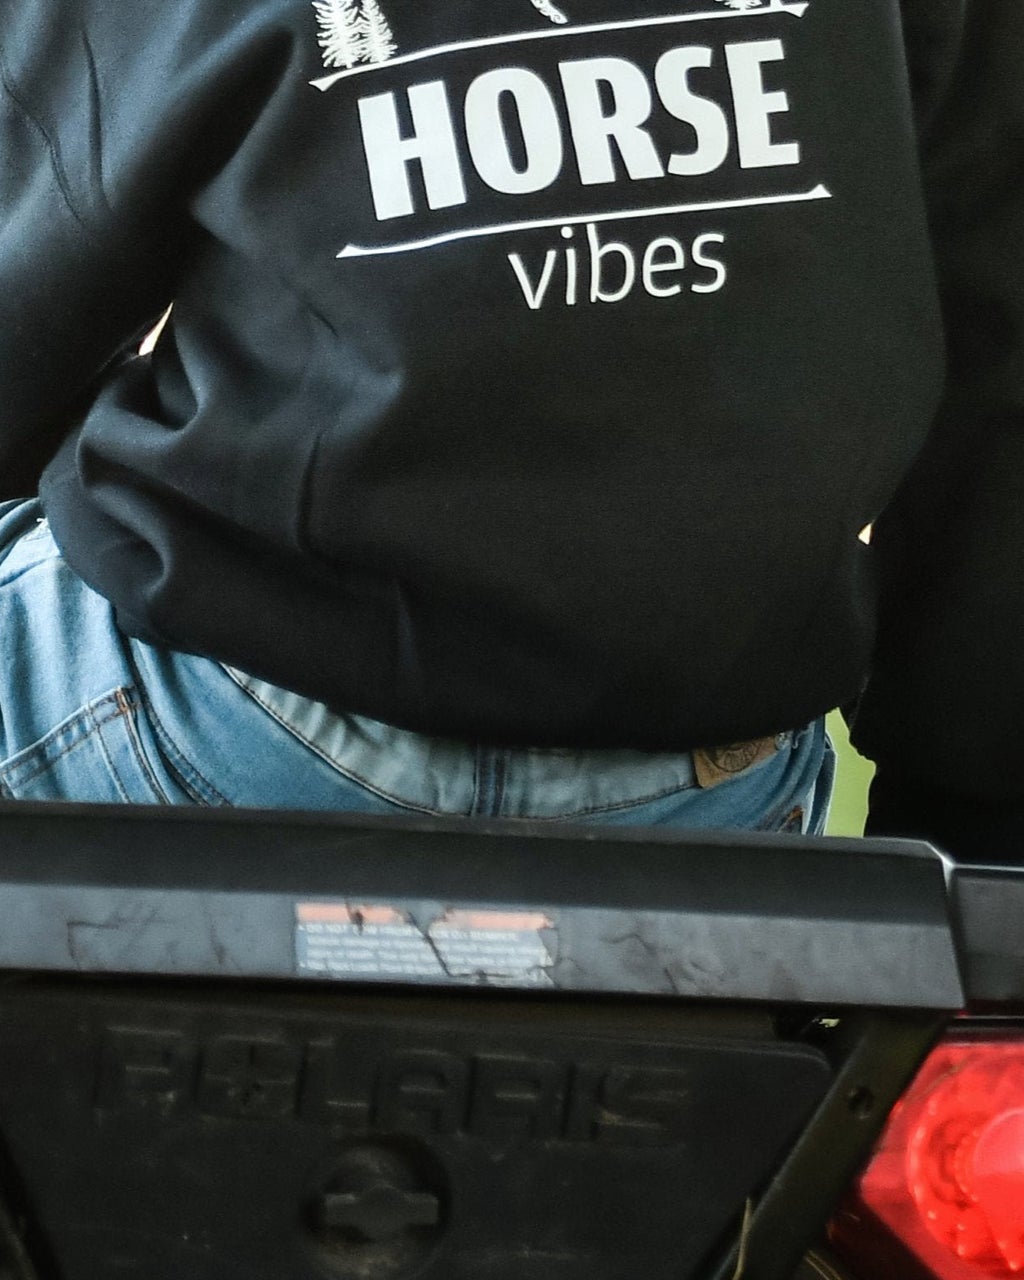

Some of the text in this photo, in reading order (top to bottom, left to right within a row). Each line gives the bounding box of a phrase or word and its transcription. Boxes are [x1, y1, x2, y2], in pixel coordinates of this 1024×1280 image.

[357, 39, 800, 221] HORSE
[508, 223, 726, 310] vibes
[95, 1025, 690, 1144] POLARIS
